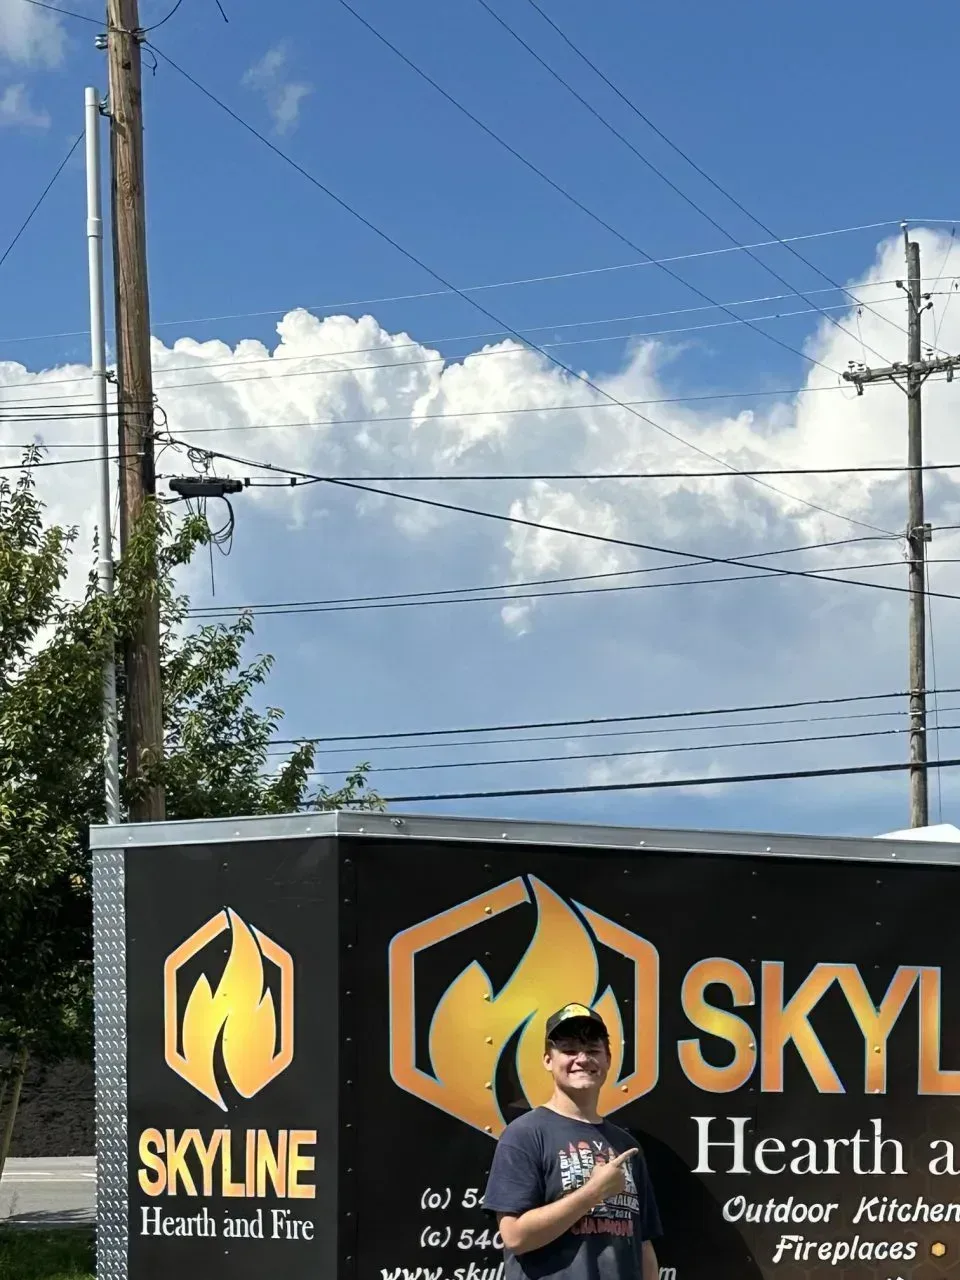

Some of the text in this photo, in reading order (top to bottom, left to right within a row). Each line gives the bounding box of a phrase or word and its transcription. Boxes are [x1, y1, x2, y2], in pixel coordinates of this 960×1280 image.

[690, 1115, 908, 1176] Hearth
[137, 1127, 317, 1199] SKYLINE
[421, 1187, 486, 1210] (o) 5
[721, 1195, 838, 1224] Outdoor
[140, 1206, 315, 1241] Hearth and Fire
[420, 1225, 452, 1248] (c)
[772, 1235, 918, 1264] Fireplaces
